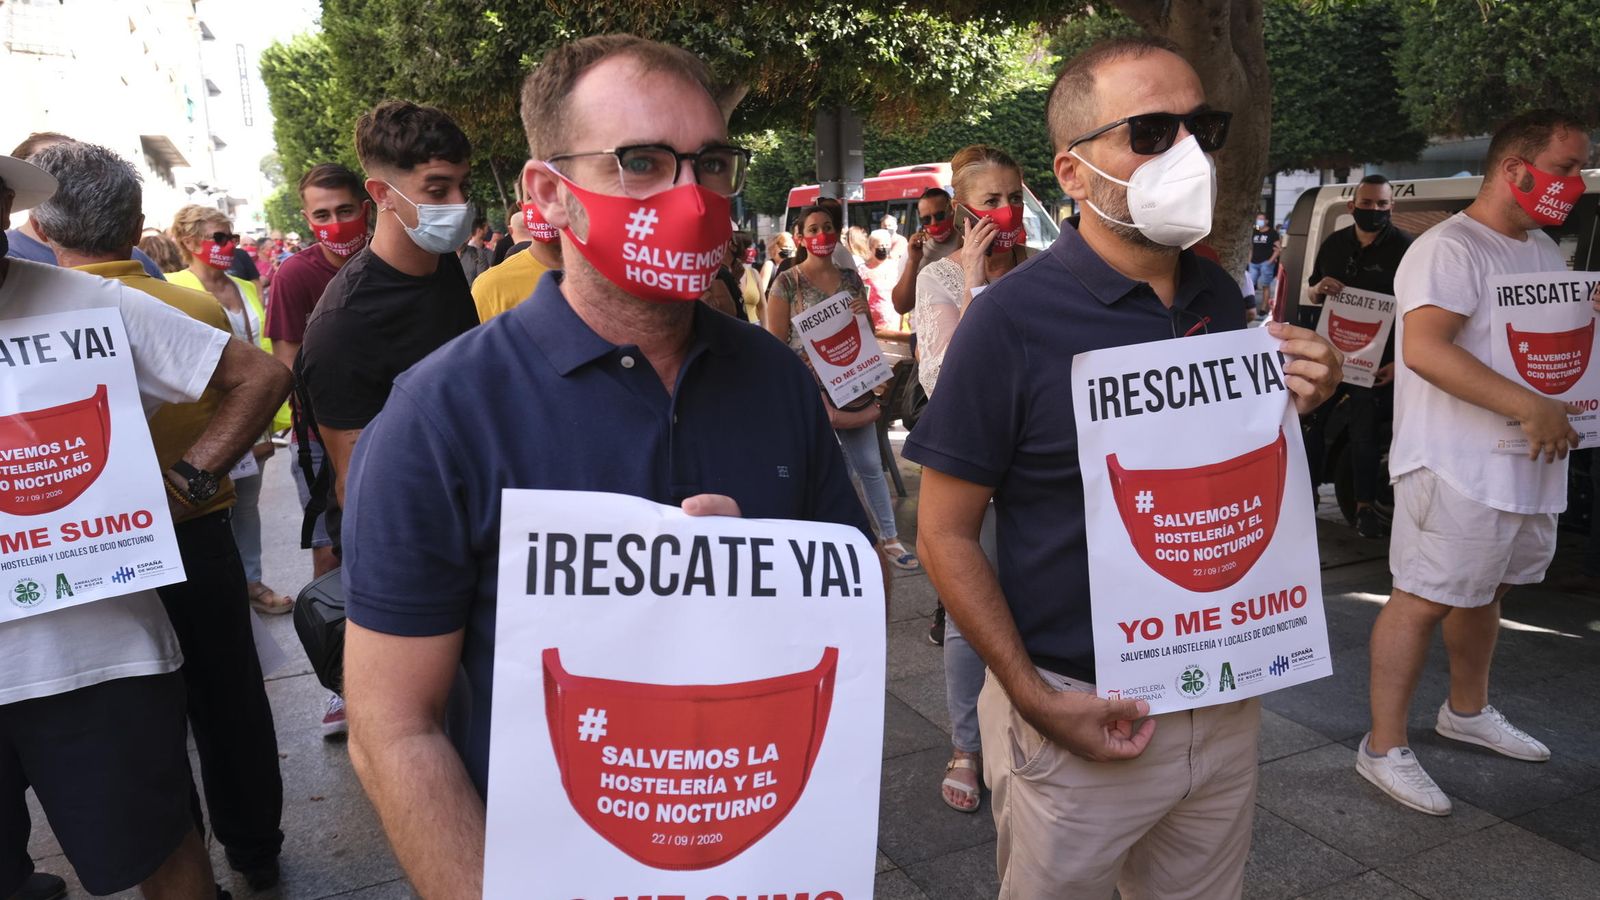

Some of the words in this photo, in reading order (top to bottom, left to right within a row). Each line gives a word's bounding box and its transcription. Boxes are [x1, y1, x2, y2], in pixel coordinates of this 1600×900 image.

[1390, 183, 1415, 198] 7A
[1546, 181, 1564, 196] #
[526, 208, 534, 220] #
[625, 207, 659, 241] #
[1496, 281, 1582, 307] ¡RESCATE
[59, 326, 117, 361] YA!
[1518, 341, 1529, 353] #
[1527, 352, 1572, 362] SALVEMOS
[1572, 350, 1582, 358] LA
[829, 376, 843, 386] YO
[843, 368, 857, 380] ME
[856, 354, 880, 371] SUMO
[1526, 370, 1545, 379] OCIO
[1088, 357, 1243, 422] ¡RESCATE
[0, 442, 61, 462] VEMOS
[64, 436, 87, 451] LA
[0, 458, 58, 475] TELERÍA
[60, 455, 69, 465] Y
[72, 451, 89, 462] EL
[13, 462, 92, 491] NOCTURNO
[1134, 490, 1155, 514] #
[1153, 503, 1240, 528] SALVEMOS
[1243, 495, 1262, 513] LA
[0, 527, 52, 554] ME
[60, 509, 154, 543] SUMO
[1155, 524, 1235, 544] HOSTELERÍA
[1237, 519, 1246, 531] Y
[1248, 513, 1263, 528] EL
[1, 553, 48, 571] HOSTELERÍA
[49, 551, 54, 561] Y
[55, 547, 88, 560] LOCALES
[89, 544, 99, 554] DE
[100, 540, 116, 552] OCIO
[117, 534, 154, 549] NOCTURNO
[1155, 548, 1190, 562] OCIO
[1193, 527, 1264, 562] NOCTURNO
[526, 532, 777, 598] ¡RESCATE
[788, 539, 863, 598] YA!
[1118, 616, 1164, 644] YO
[1175, 607, 1222, 636] ME
[1230, 585, 1308, 626] SUMO
[1120, 647, 1160, 663] SALVEMOS
[1161, 645, 1172, 656] LA
[1172, 638, 1217, 655] HOSTELERÍA
[1217, 638, 1223, 647] Y
[1224, 633, 1253, 647] LOCALES
[1253, 630, 1261, 640] DE
[1262, 624, 1276, 636] OCIO
[1276, 615, 1308, 632] NOCTURNO
[577, 707, 608, 743] #
[602, 746, 740, 771] SALVEMOS
[747, 743, 779, 766] LA
[600, 772, 728, 796] HOSTELERÍA
[734, 775, 748, 791] Y
[753, 770, 778, 788] EL
[597, 796, 650, 822] OCIO
[656, 792, 778, 824] NOCTURNO
